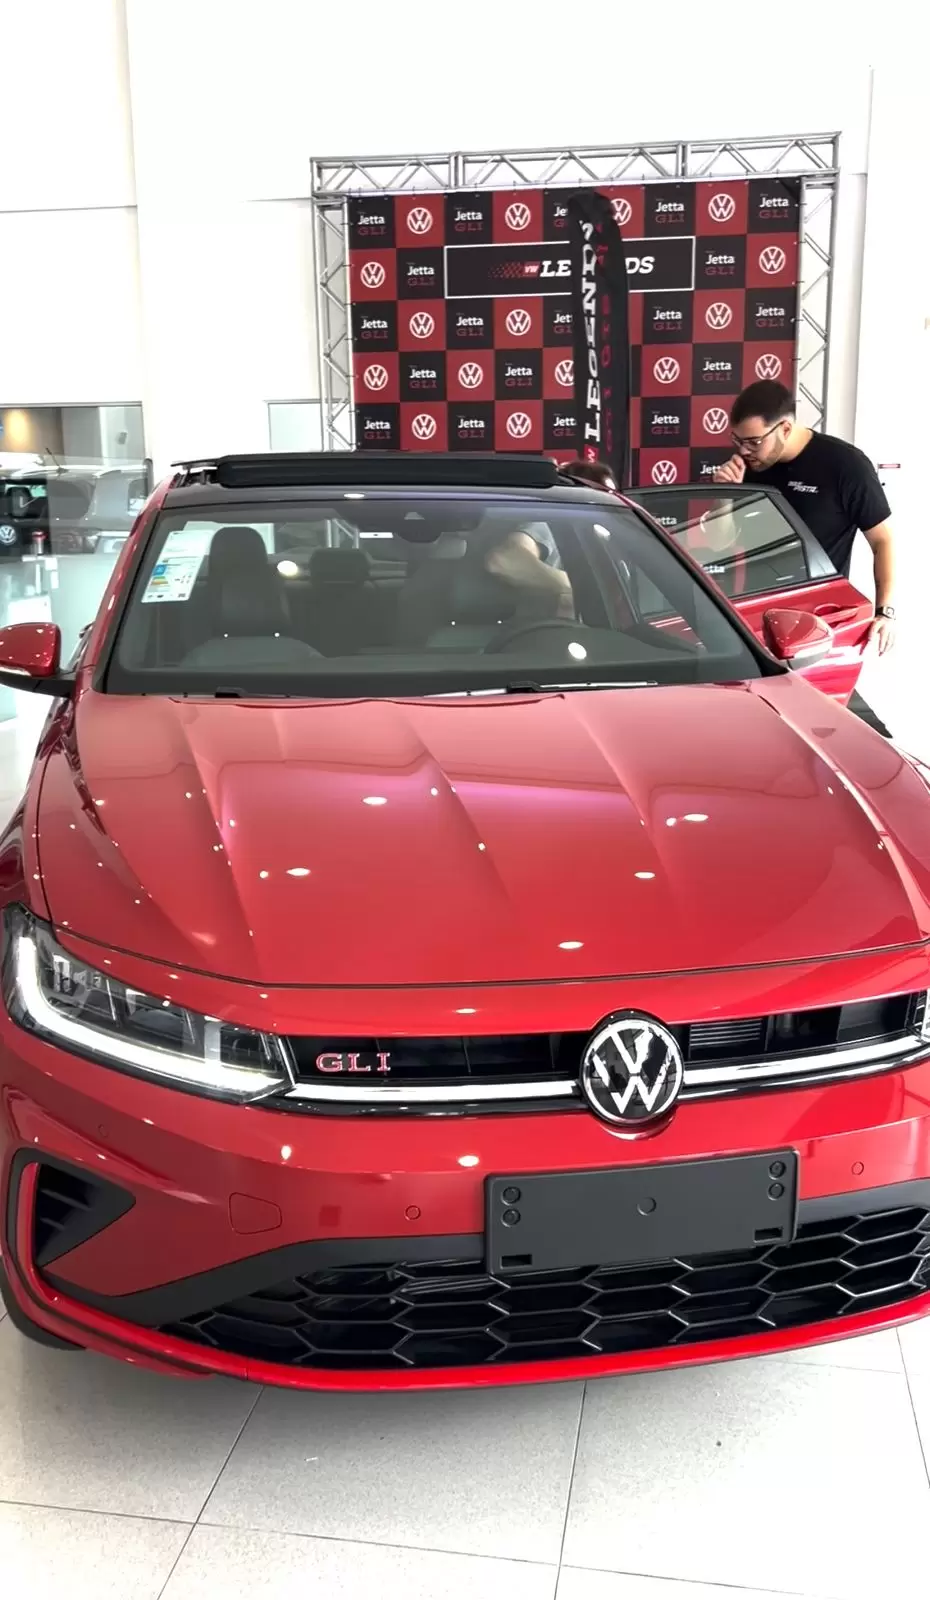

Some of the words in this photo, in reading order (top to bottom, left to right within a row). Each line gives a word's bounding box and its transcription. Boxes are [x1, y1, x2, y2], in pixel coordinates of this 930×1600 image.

[655, 201, 685, 213] Jetta
[759, 196, 790, 208] Jetta
[454, 210, 483, 222] Jetta
[656, 214, 686, 223] GLI
[760, 209, 791, 218] GLI
[357, 215, 385, 225] Jetta
[358, 226, 386, 235] GLI
[455, 223, 484, 232] GLI
[705, 254, 736, 265] Jetta
[407, 265, 435, 276] Jetta
[524, 264, 539, 274] VW
[706, 266, 737, 275] GLI
[408, 277, 436, 286] GLI
[653, 309, 683, 321] Jetta
[755, 306, 785, 317] Jetta
[360, 319, 389, 329] Jetta
[455, 316, 484, 327] Jetta
[654, 322, 684, 331] GLI
[756, 318, 786, 327] GLI
[361, 330, 390, 339] GLI
[456, 328, 485, 337] GLI
[702, 360, 733, 371] Jetta
[409, 368, 437, 379] Jetta
[504, 366, 533, 377] Jetta
[703, 372, 734, 381] GLI
[410, 380, 438, 389] GLI
[505, 378, 534, 387] GLI
[457, 418, 485, 429] Jetta
[553, 416, 577, 427] Jett
[651, 414, 680, 425] Jetta
[364, 420, 391, 430] Jetta
[365, 431, 392, 440] GLI
[458, 430, 486, 439] GLI
[652, 426, 681, 435] GLI
[315, 1051, 392, 1074] GLI
[583, 1016, 684, 1121] VW
